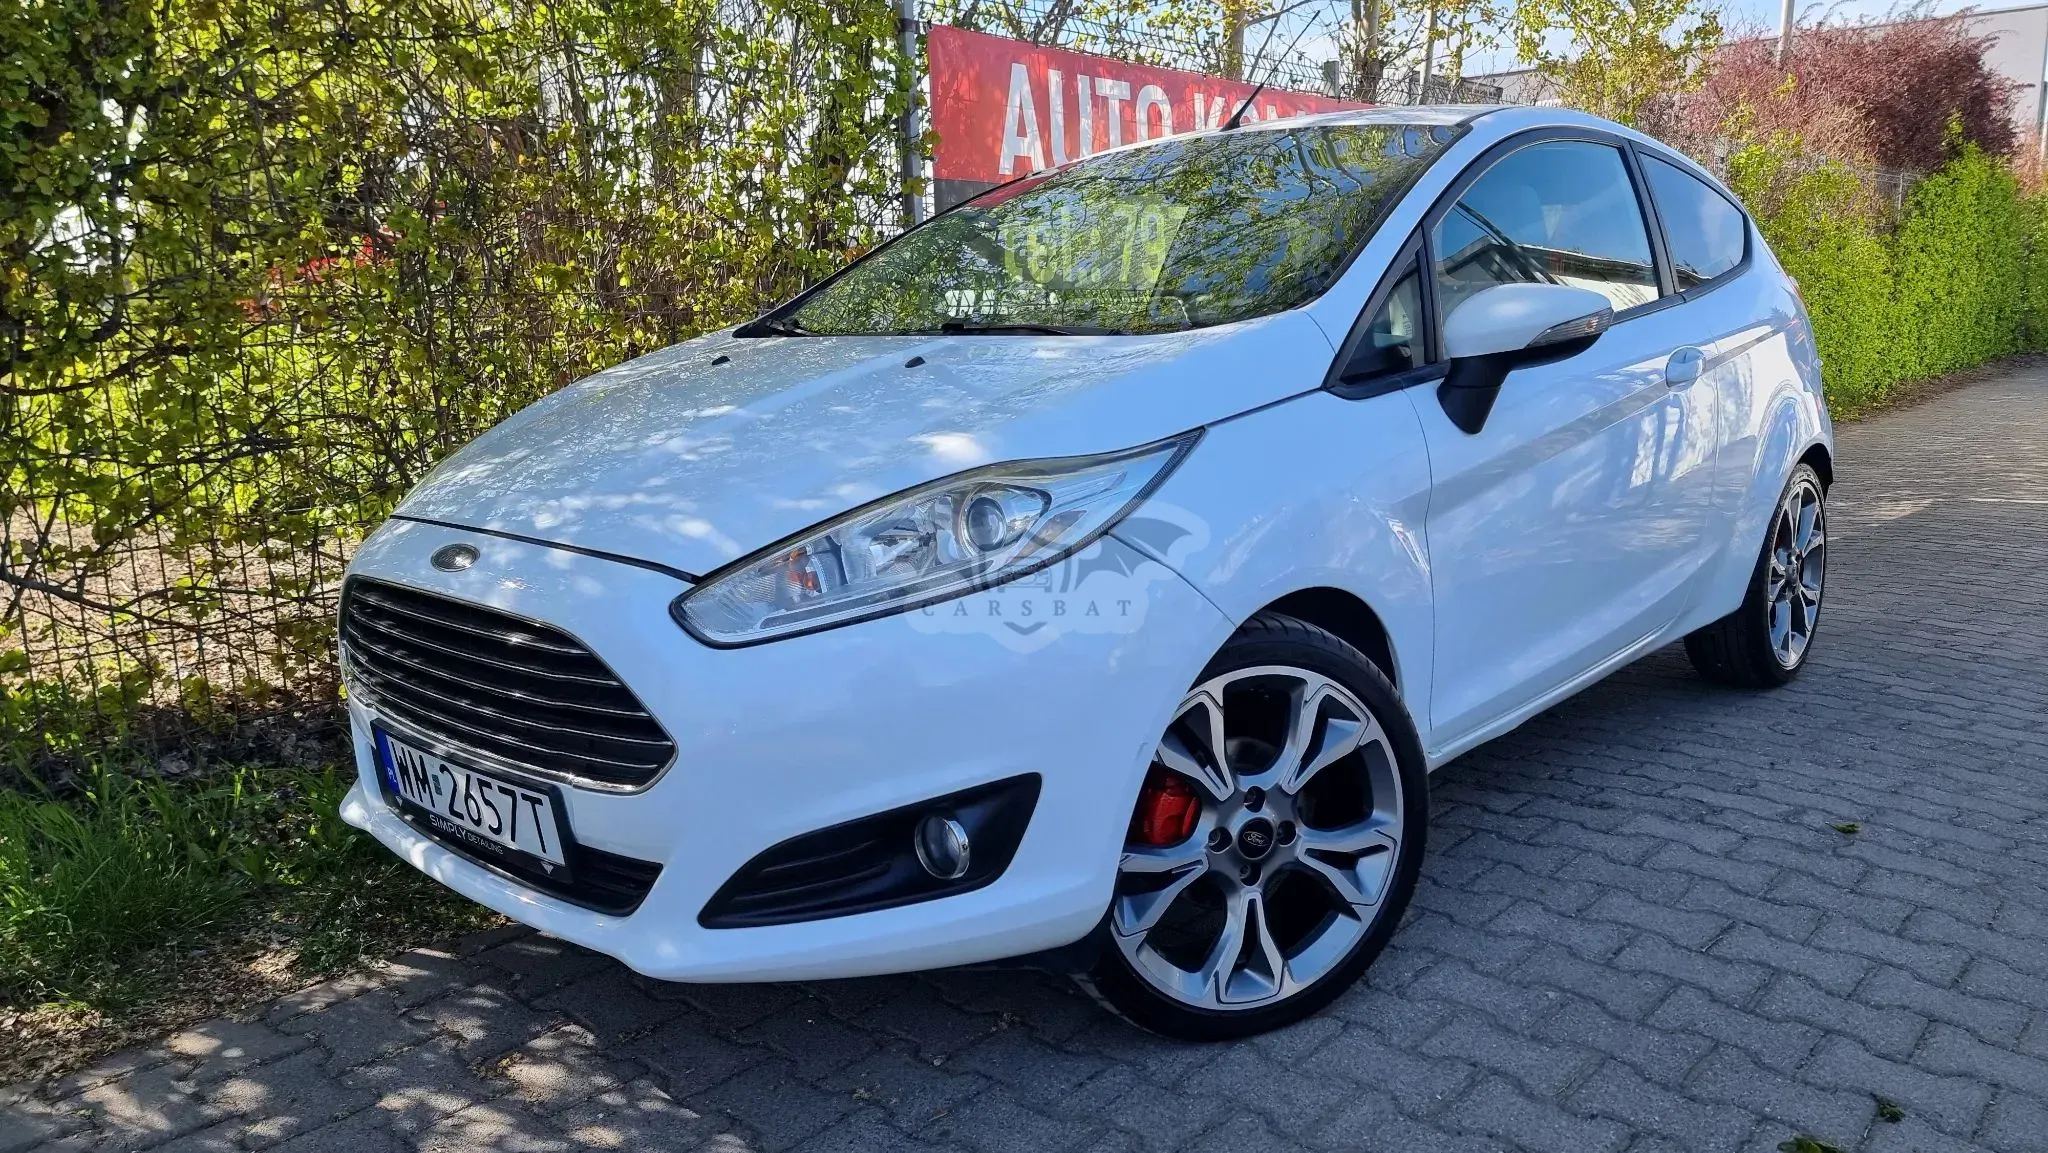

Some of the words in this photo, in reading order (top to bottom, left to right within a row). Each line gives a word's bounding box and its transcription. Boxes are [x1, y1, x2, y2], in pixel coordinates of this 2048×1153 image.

[391, 740, 435, 809] WM
[439, 763, 547, 855] 2657T
[429, 814, 467, 840] SIMPLY
[467, 832, 504, 855] DETAILING
